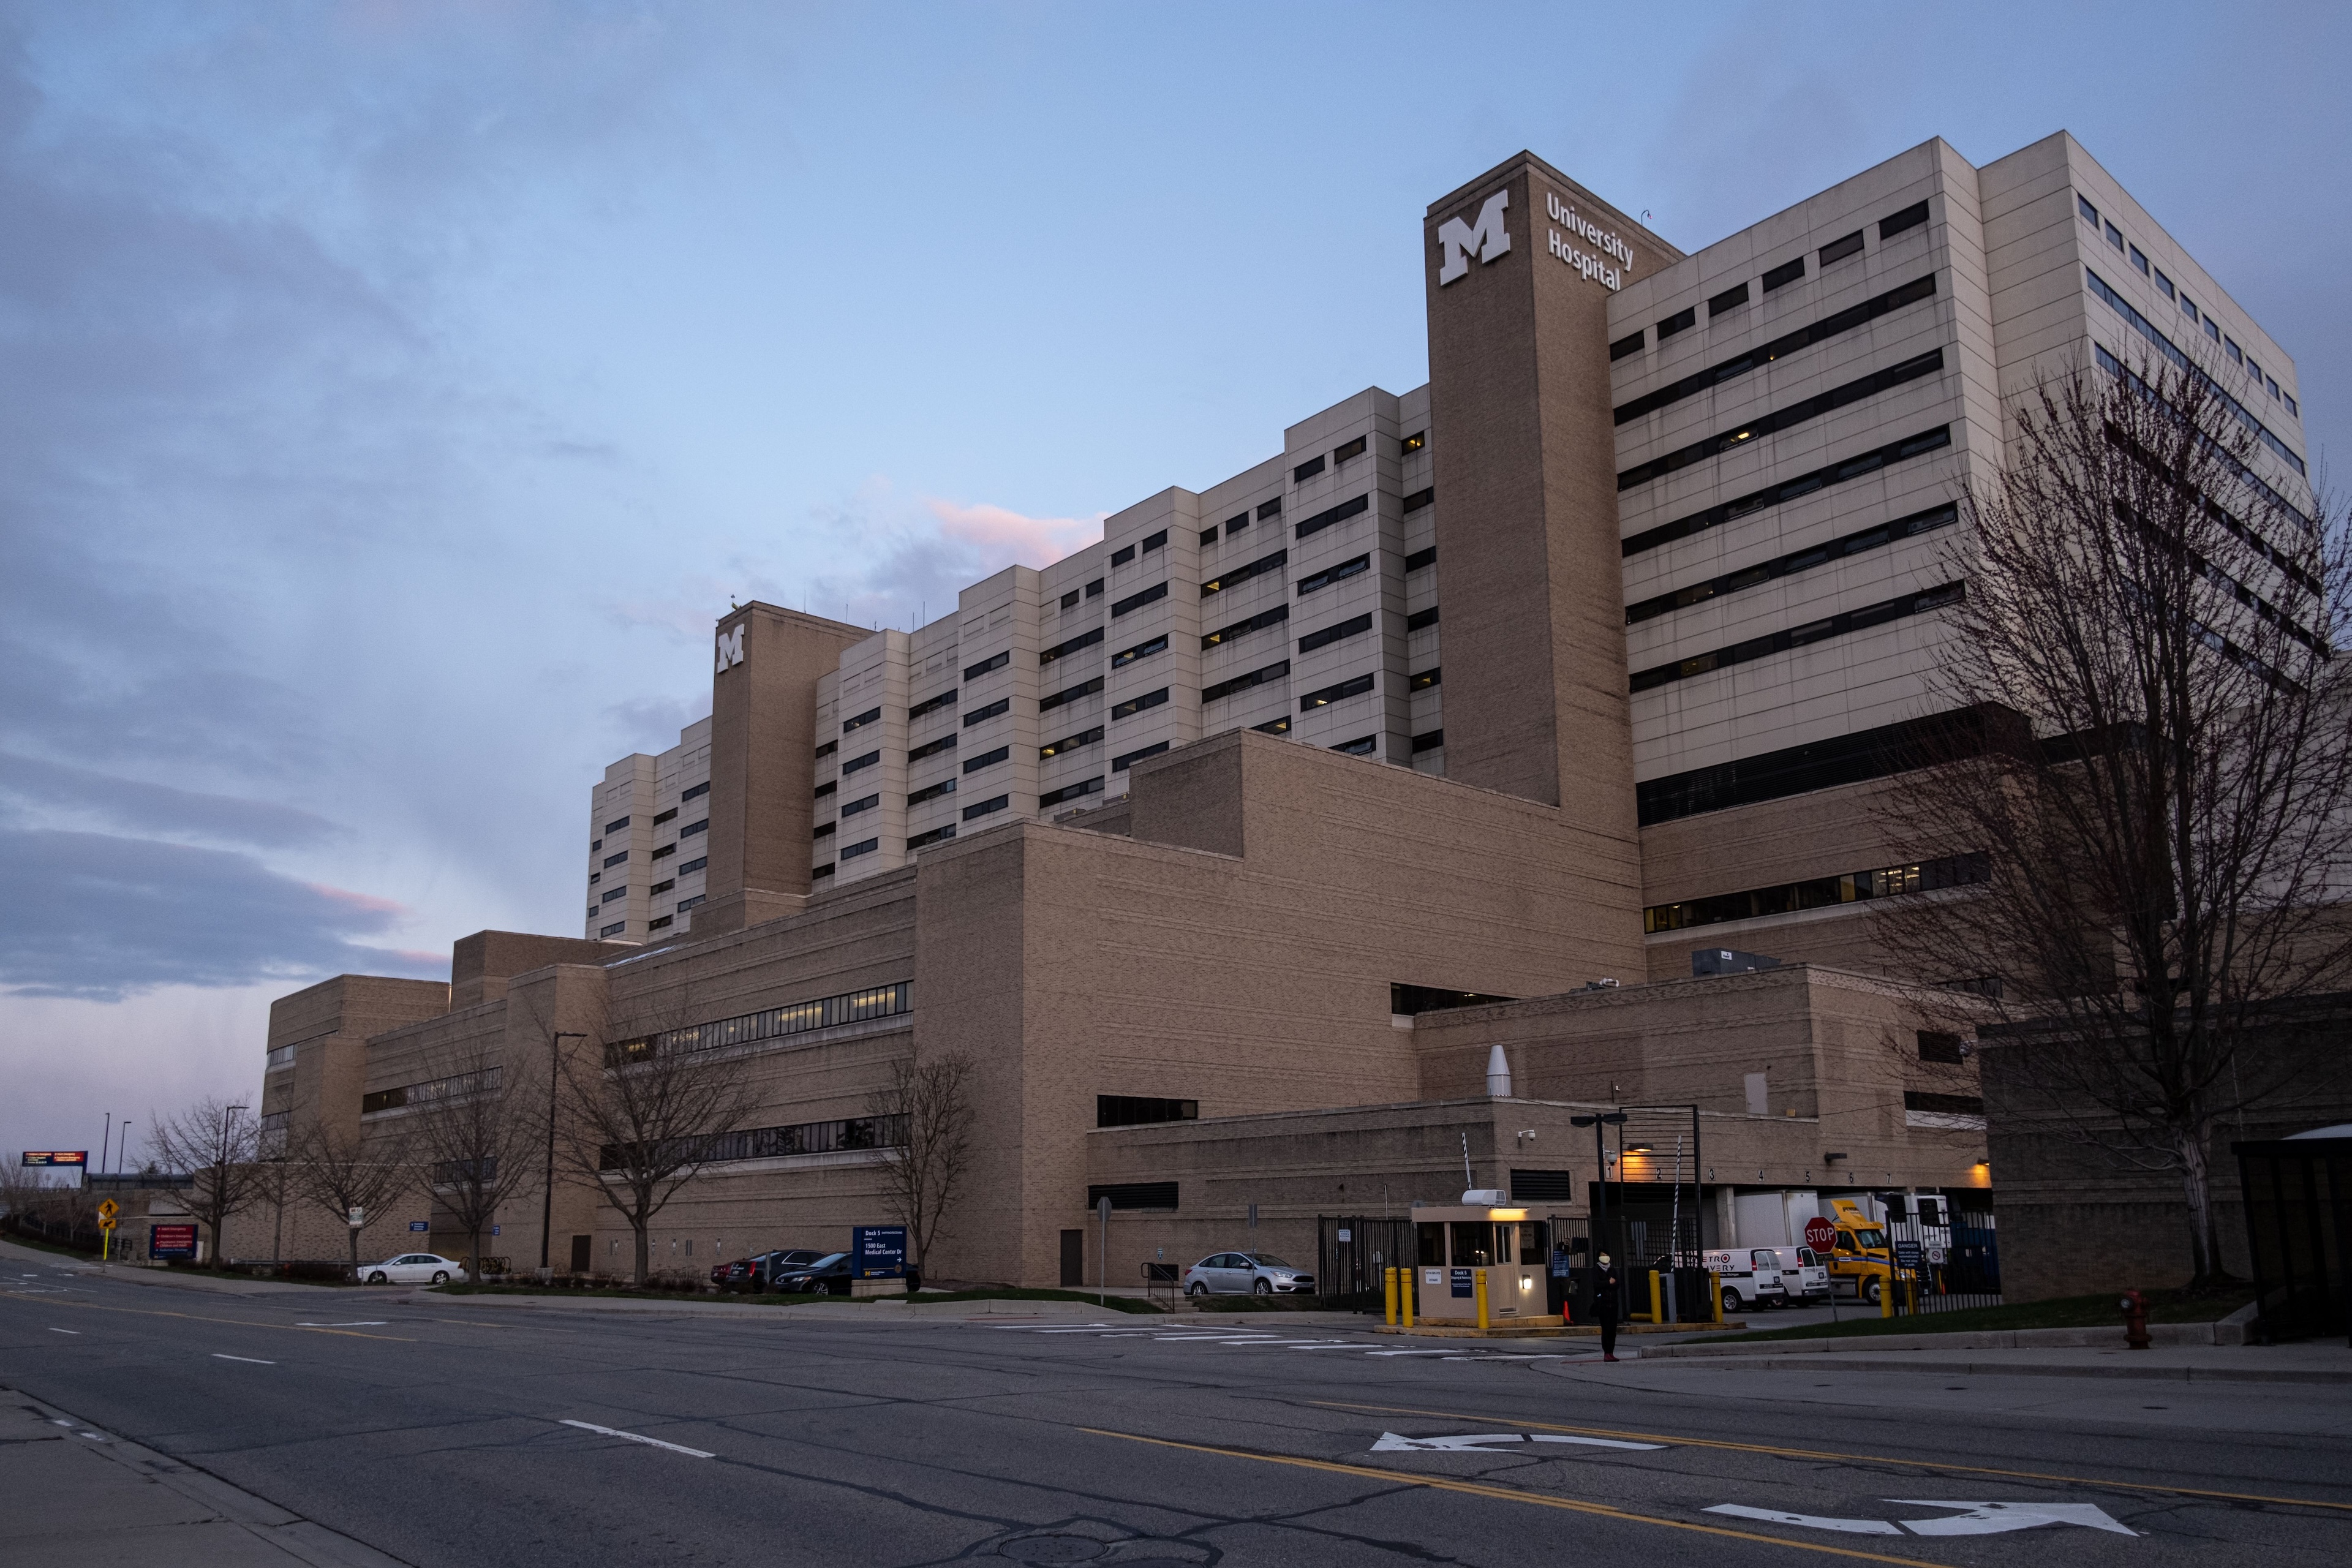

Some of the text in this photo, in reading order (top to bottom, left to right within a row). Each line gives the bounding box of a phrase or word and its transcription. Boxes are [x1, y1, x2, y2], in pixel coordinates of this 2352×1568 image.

[1438, 189, 1511, 286] M
[1546, 192, 1634, 273] University
[1547, 228, 1621, 292] Hospital
[717, 624, 745, 674] M
[1607, 1166, 1611, 1178] 1
[1656, 1168, 1661, 1179] 2
[1709, 1169, 1714, 1180] 3
[1759, 1170, 1763, 1181] 4
[1806, 1171, 1810, 1182] 5
[1849, 1172, 1853, 1183] 6
[1887, 1173, 1891, 1183] 7
[1807, 1227, 1834, 1243] STOP
[1702, 1254, 1730, 1264] ETRO
